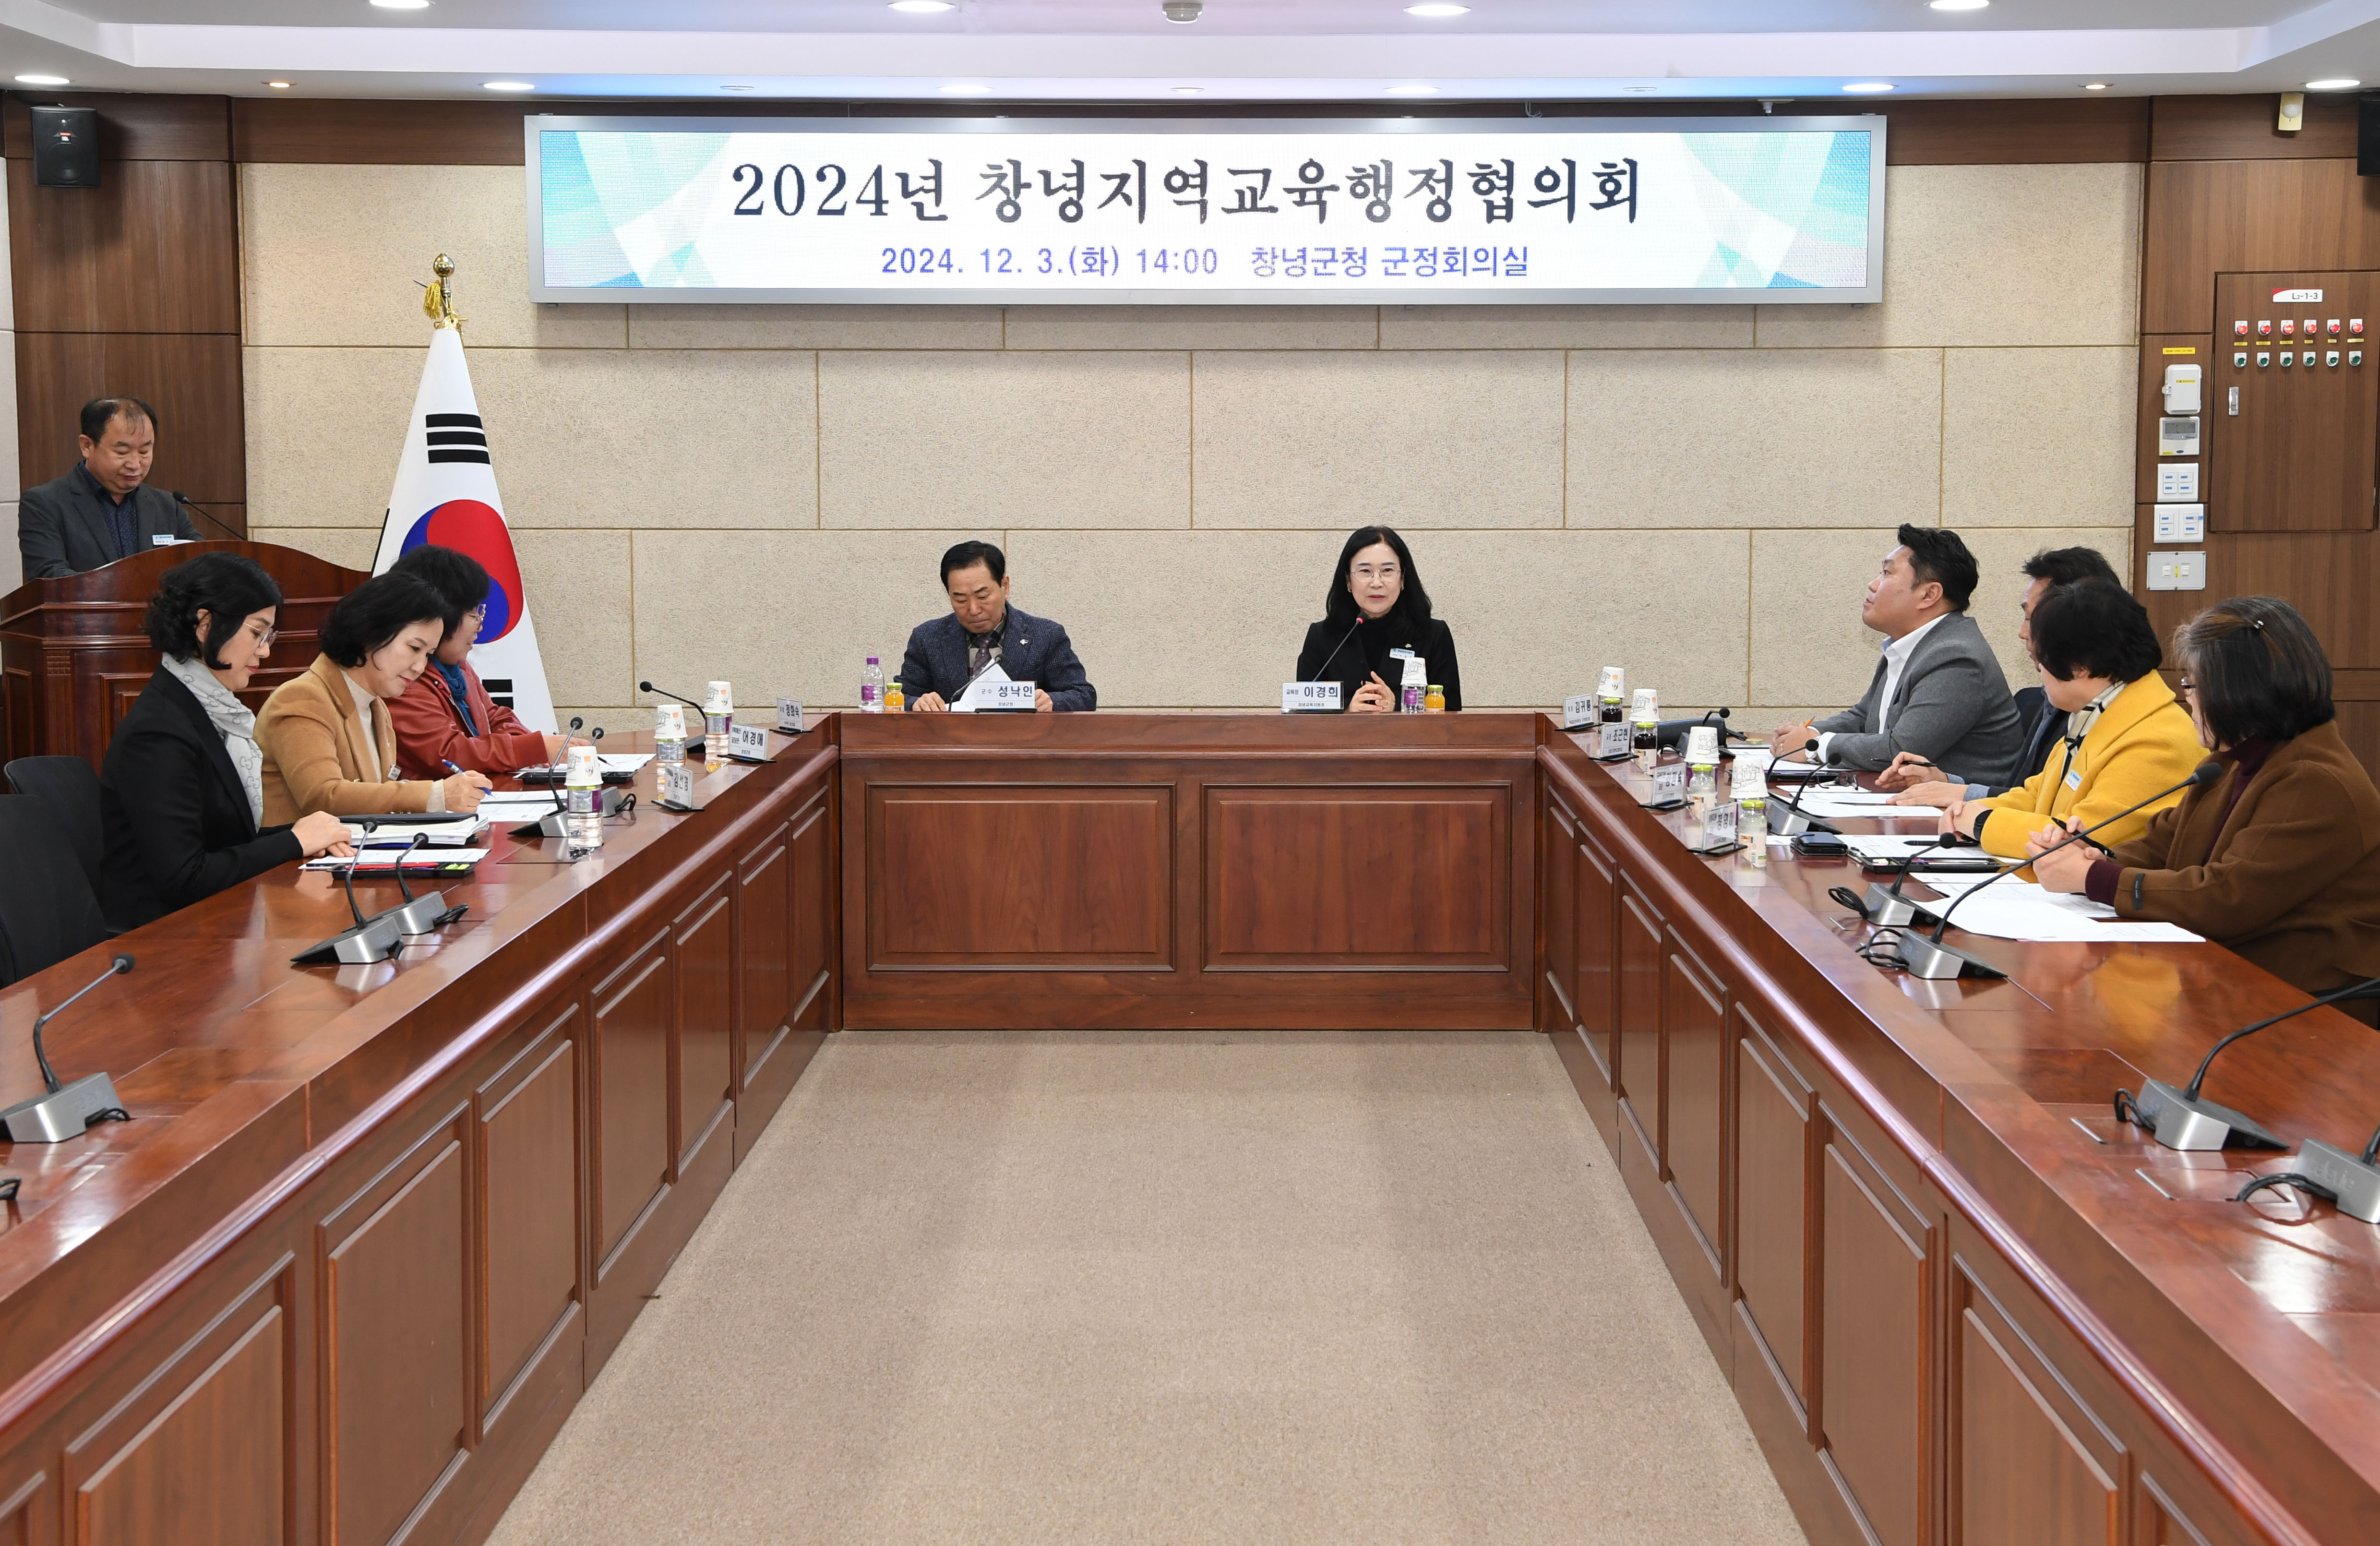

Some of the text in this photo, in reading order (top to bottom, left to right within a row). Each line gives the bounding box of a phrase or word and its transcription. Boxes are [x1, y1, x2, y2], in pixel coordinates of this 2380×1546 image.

[733, 158, 1638, 224] 2024년 창녕지역교육행정협의회
[882, 246, 1527, 277] 2024. 12. 3.(화) 14:00 창녕군청 군정회의실
[998, 685, 1032, 697] 성낙인
[1304, 686, 1338, 698] 이경희
[742, 730, 764, 746] 어경애
[1613, 727, 1628, 742] 조근현
